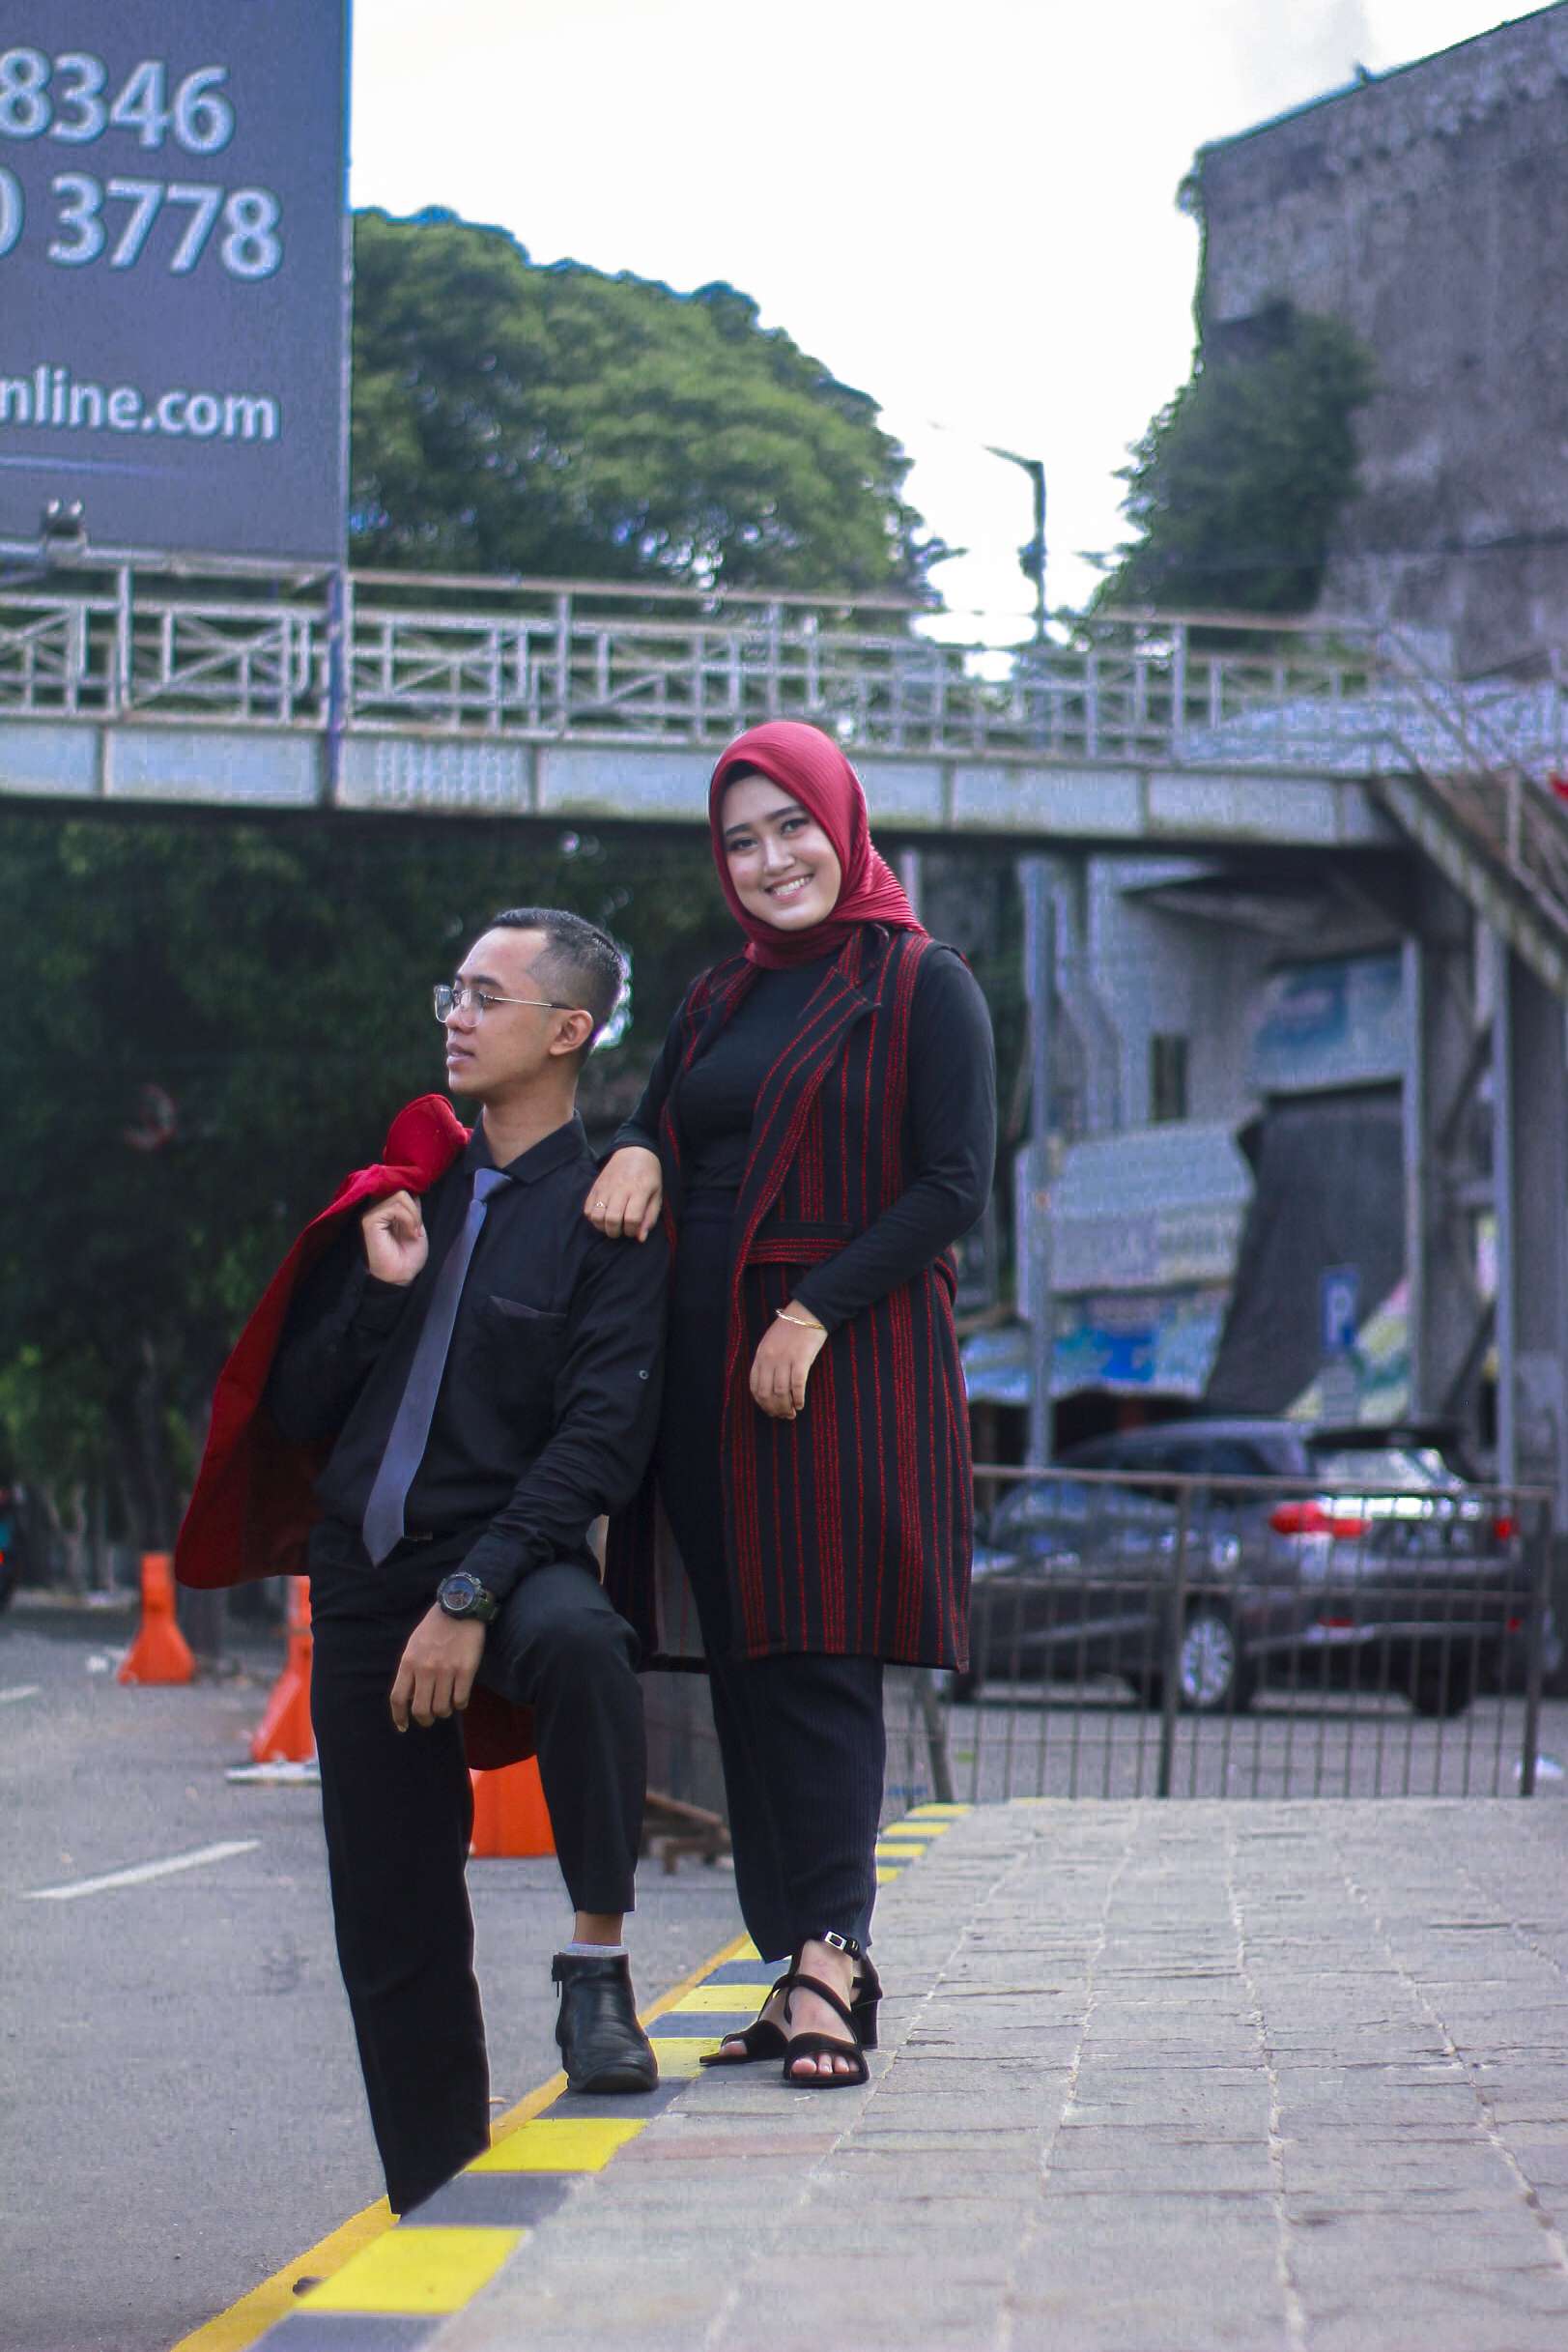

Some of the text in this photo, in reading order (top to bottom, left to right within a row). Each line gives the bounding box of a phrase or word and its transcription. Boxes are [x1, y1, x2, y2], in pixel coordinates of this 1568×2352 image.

[0, 47, 235, 155] 8346
[49, 173, 281, 277] 3778
[0, 364, 277, 440] nline.com
